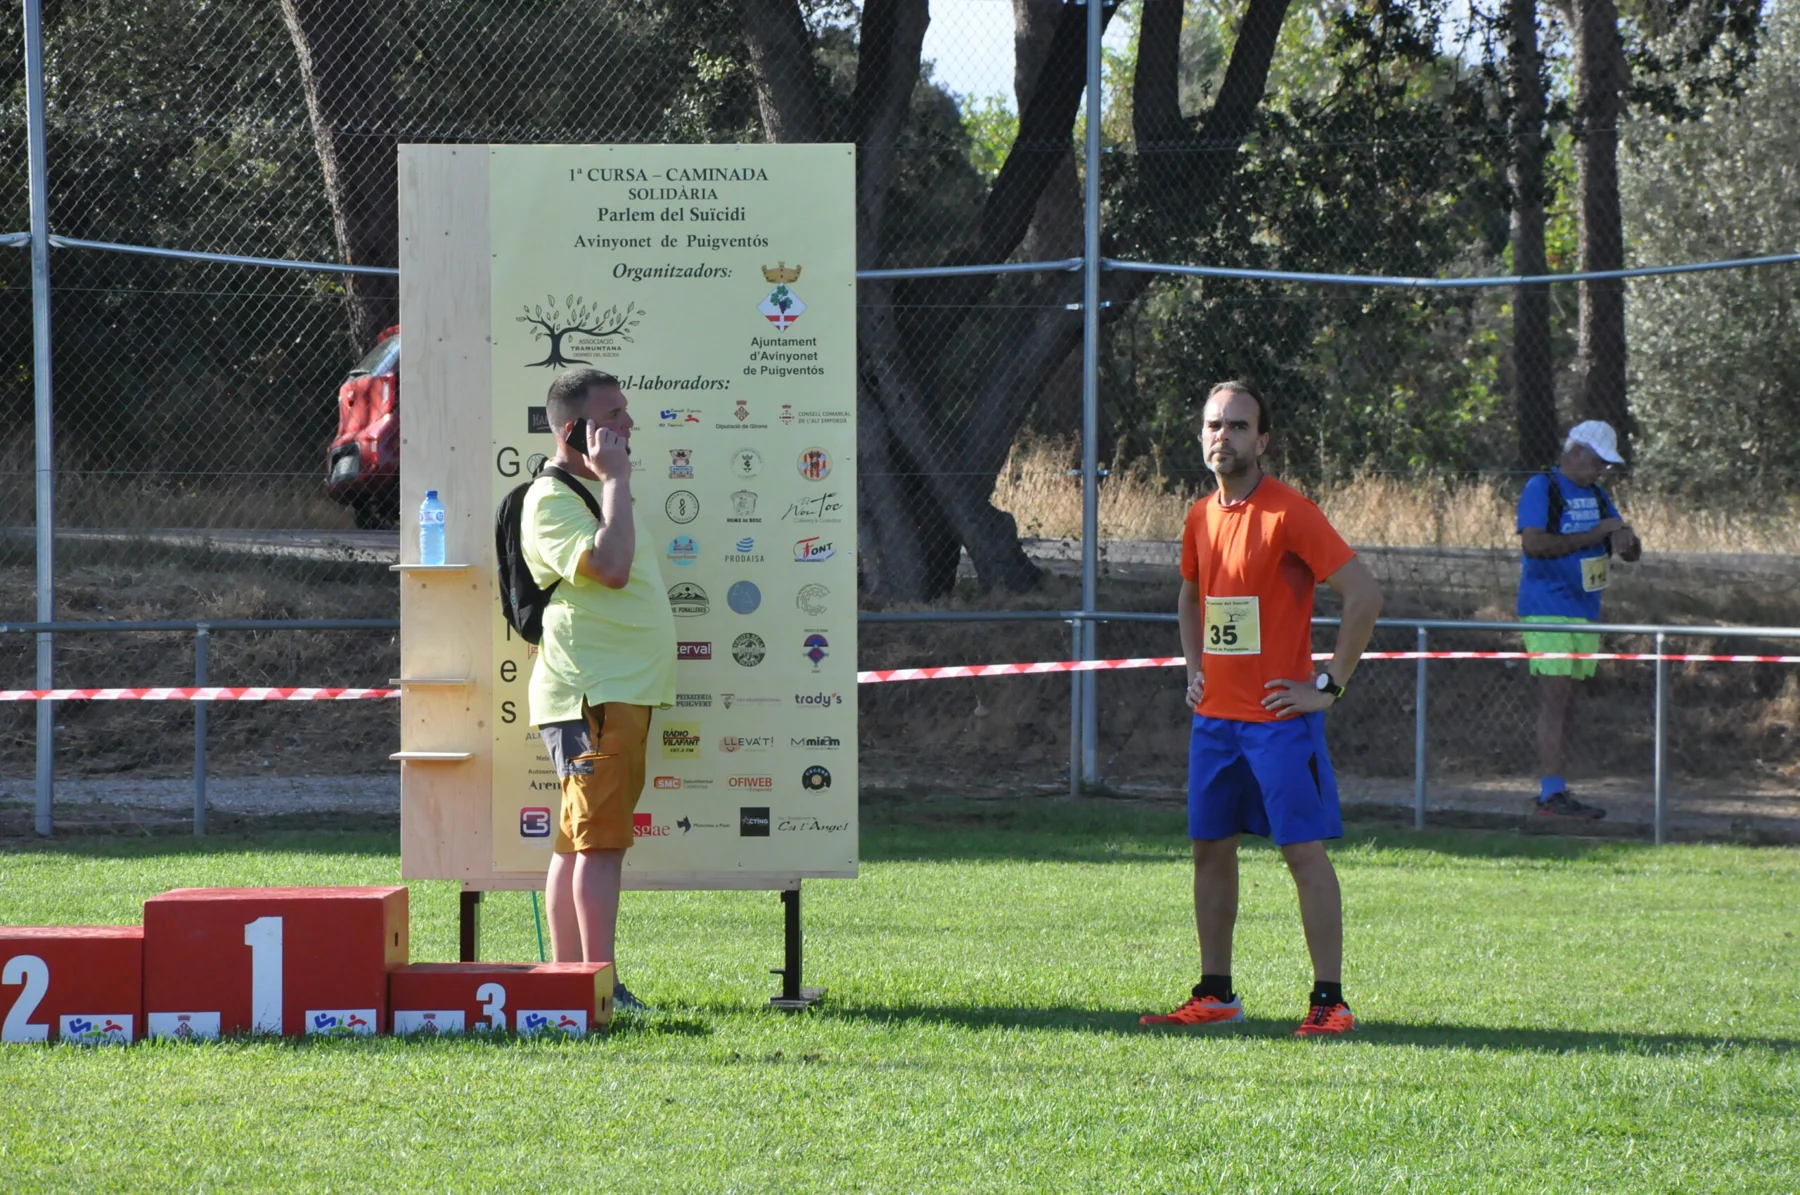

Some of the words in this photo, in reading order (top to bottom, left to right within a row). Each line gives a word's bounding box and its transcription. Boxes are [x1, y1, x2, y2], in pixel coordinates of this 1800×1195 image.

[587, 168, 648, 181] CURSA
[666, 168, 769, 181] CAMINADA
[628, 185, 718, 200] SOLIDÀRIA
[597, 207, 655, 222] Parlem
[660, 207, 684, 222] del
[690, 207, 746, 222] Suïcidi
[574, 235, 652, 251] Avinyonet
[660, 235, 678, 248] de
[687, 234, 769, 251] Puigventós
[612, 262, 732, 280] Organitzadors:
[751, 337, 818, 349] Ajuntament
[750, 351, 819, 363] d'Avinyonet
[743, 365, 757, 375] de
[760, 365, 825, 377] Puigventós
[616, 375, 730, 391] ol-laboradors:
[725, 555, 765, 563] PRODAISA
[1210, 625, 1238, 645] 35
[678, 643, 711, 655] erval
[795, 692, 843, 708] trady's
[658, 779, 680, 789] SMC
[728, 777, 773, 787] OFIWEB
[244, 916, 283, 1035] 1
[1, 954, 50, 1043] 2
[475, 982, 507, 1032] 3
